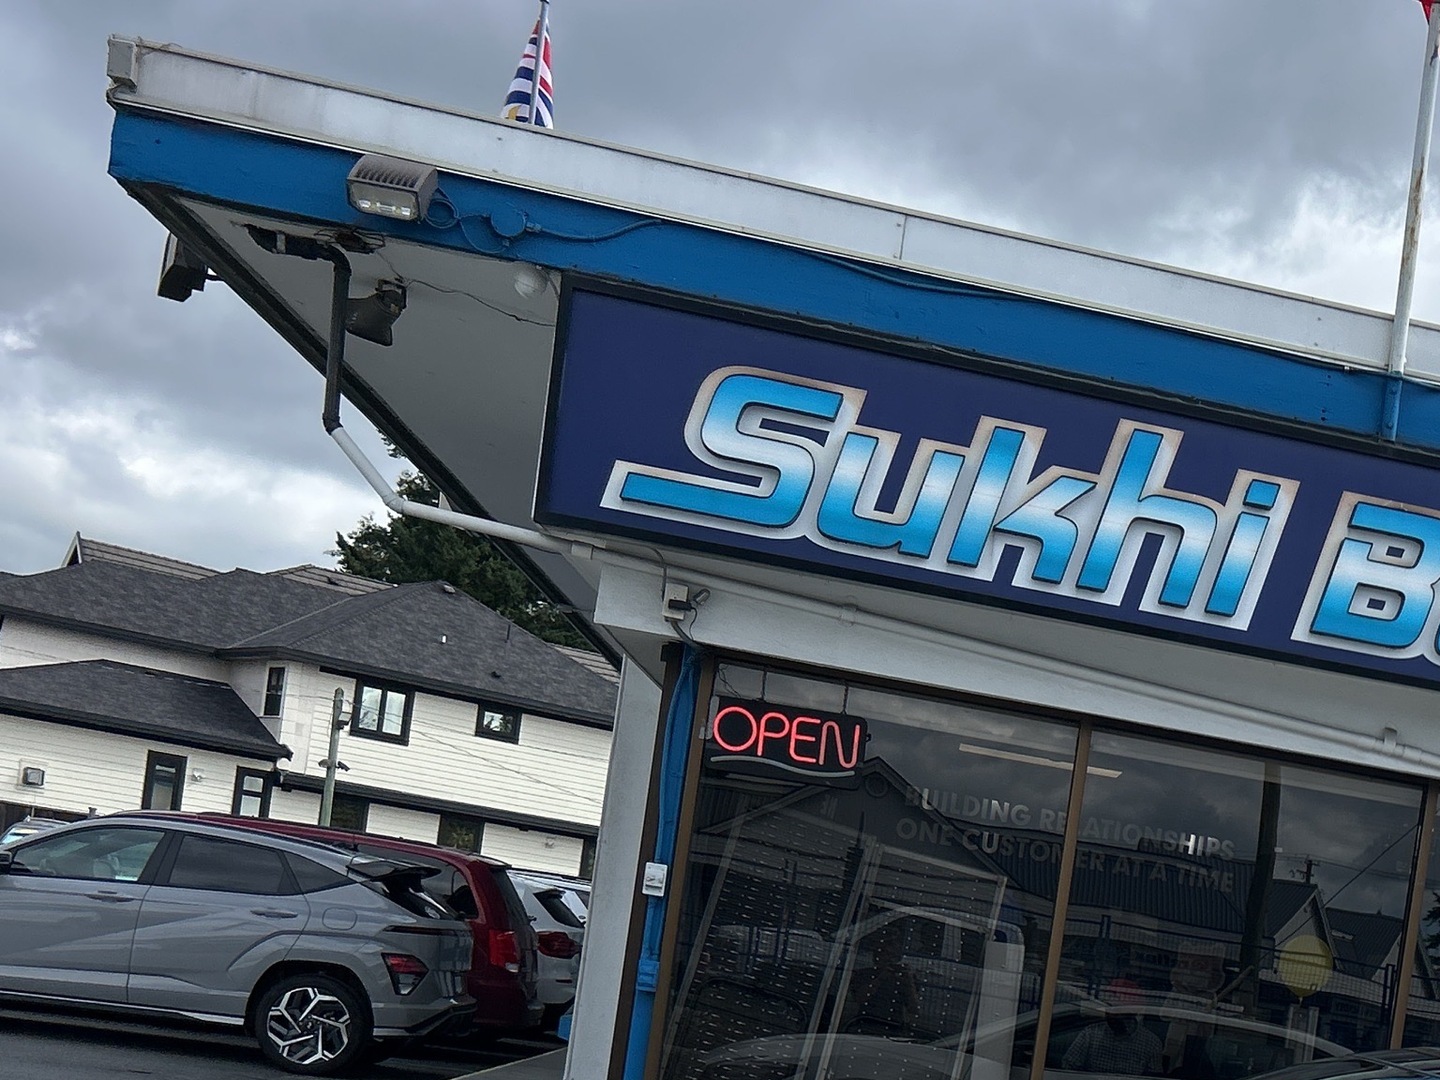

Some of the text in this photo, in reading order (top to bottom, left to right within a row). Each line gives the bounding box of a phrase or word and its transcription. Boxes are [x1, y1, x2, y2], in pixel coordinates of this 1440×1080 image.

[600, 366, 1300, 632] Sukhi
[713, 706, 861, 769] OPEN
[895, 817, 953, 848] ONE
[1112, 856, 1144, 878] AT
[1151, 862, 1167, 881] A
[1177, 863, 1235, 894] TIME
[906, 787, 1236, 861] BUILDING REATIONSHIPS
